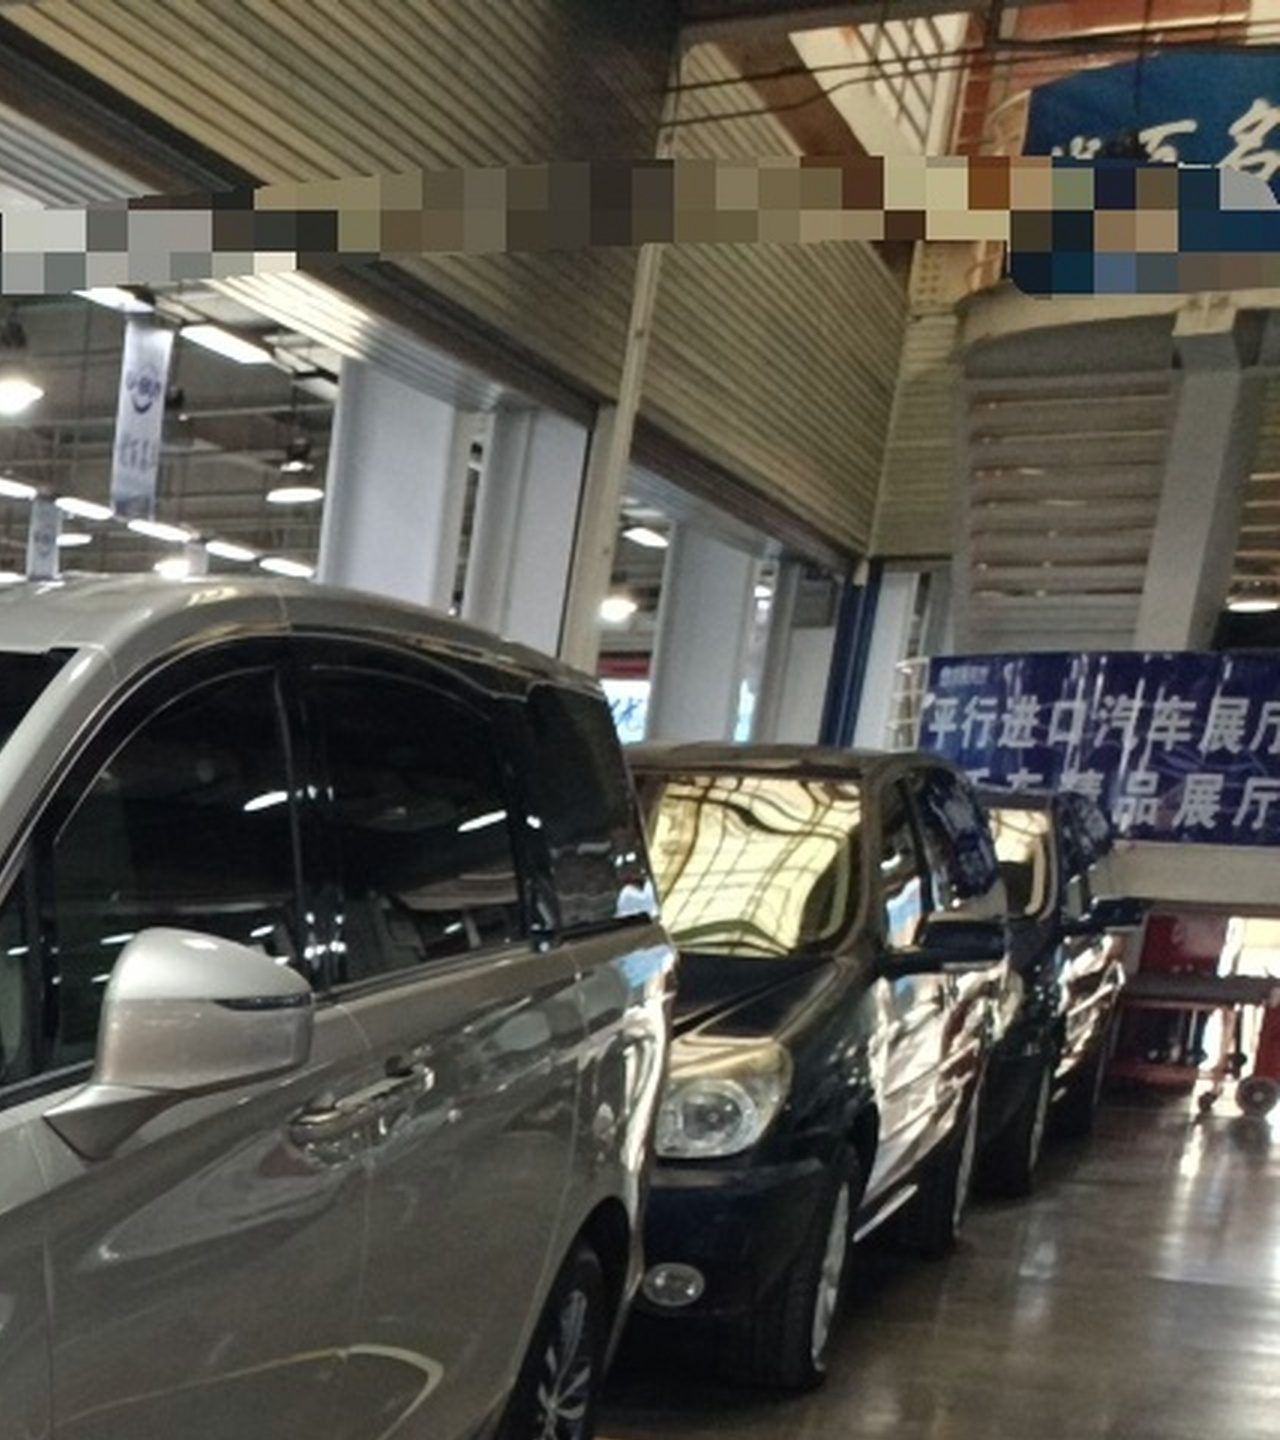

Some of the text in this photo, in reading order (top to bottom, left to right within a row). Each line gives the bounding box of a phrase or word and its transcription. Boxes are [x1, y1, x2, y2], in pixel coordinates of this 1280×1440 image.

[928, 694, 1280, 754] 平行进口汽车展厅
